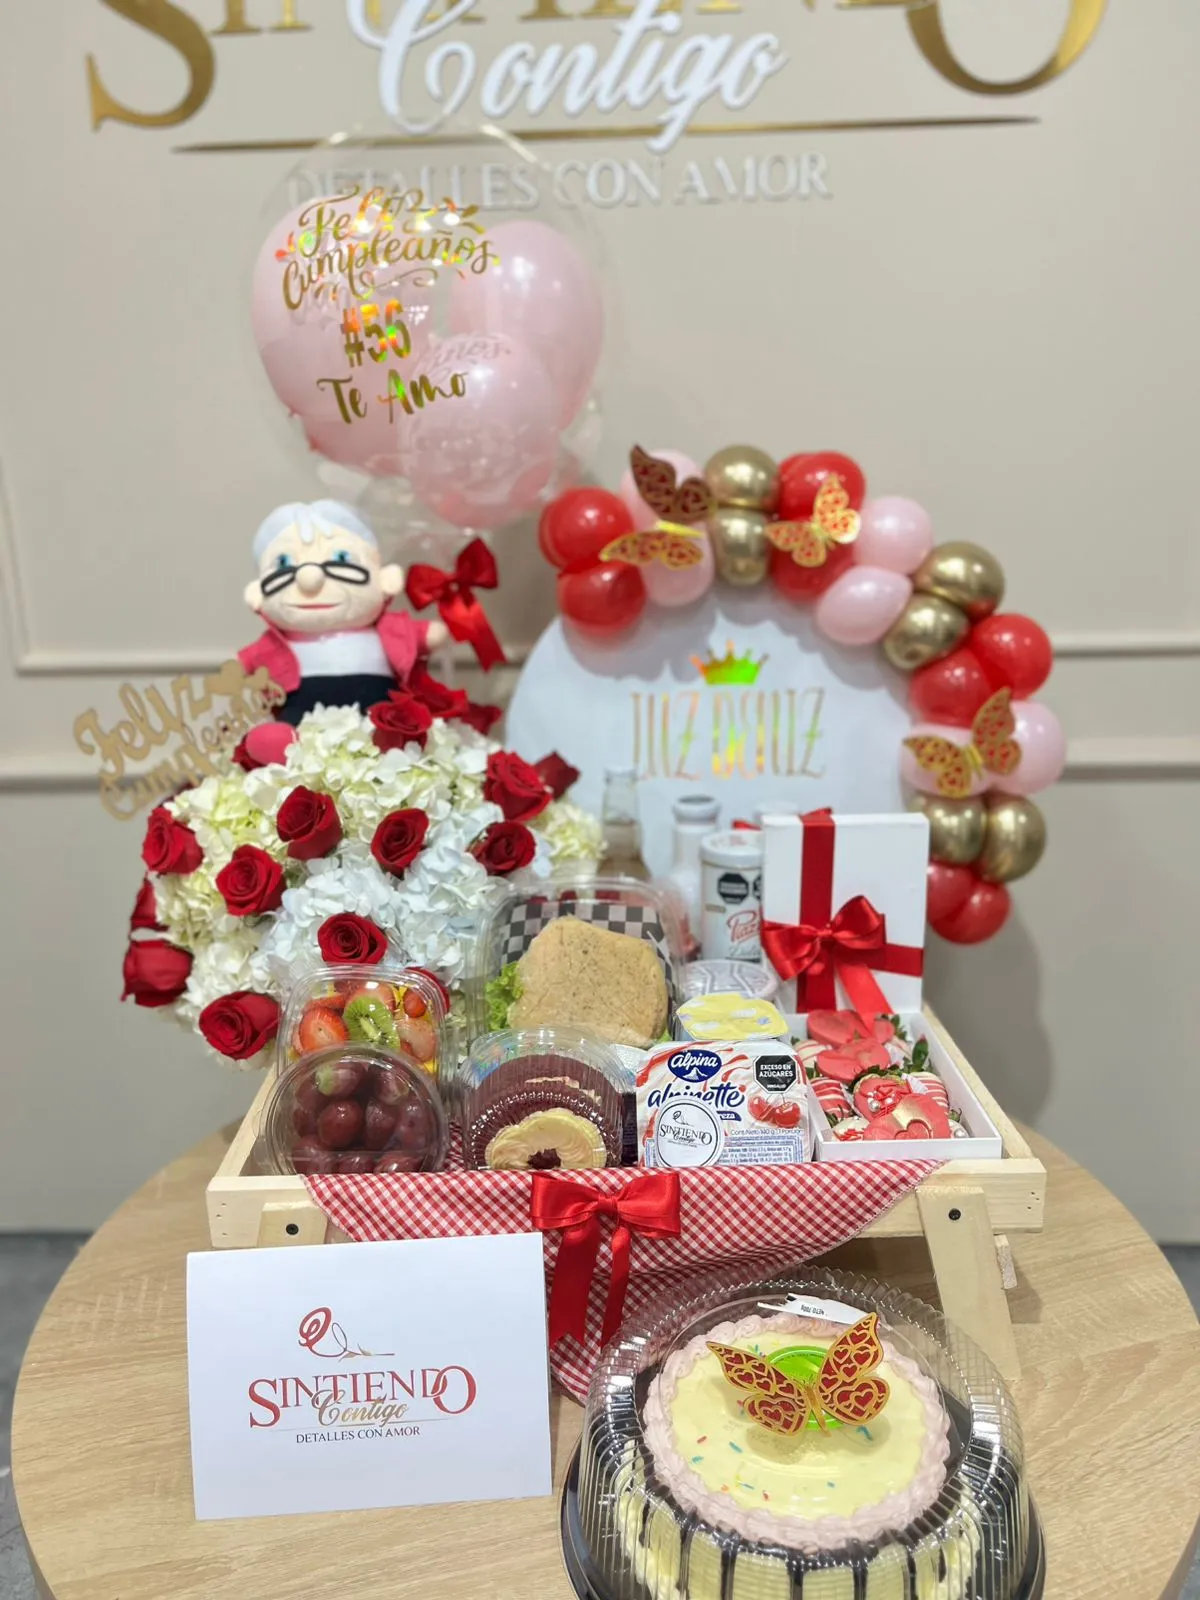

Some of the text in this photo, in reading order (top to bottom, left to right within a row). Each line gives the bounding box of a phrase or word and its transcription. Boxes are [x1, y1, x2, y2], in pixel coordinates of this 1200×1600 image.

[345, 0, 789, 152] Contigo
[553, 158, 663, 208] CON
[673, 152, 833, 204] AMOR
[316, 368, 468, 424] Te Amo
[248, 1365, 477, 1429] SINTIENDO
[311, 1389, 410, 1427] Contigo
[296, 1426, 421, 1444] DETALLES CON AMOR
